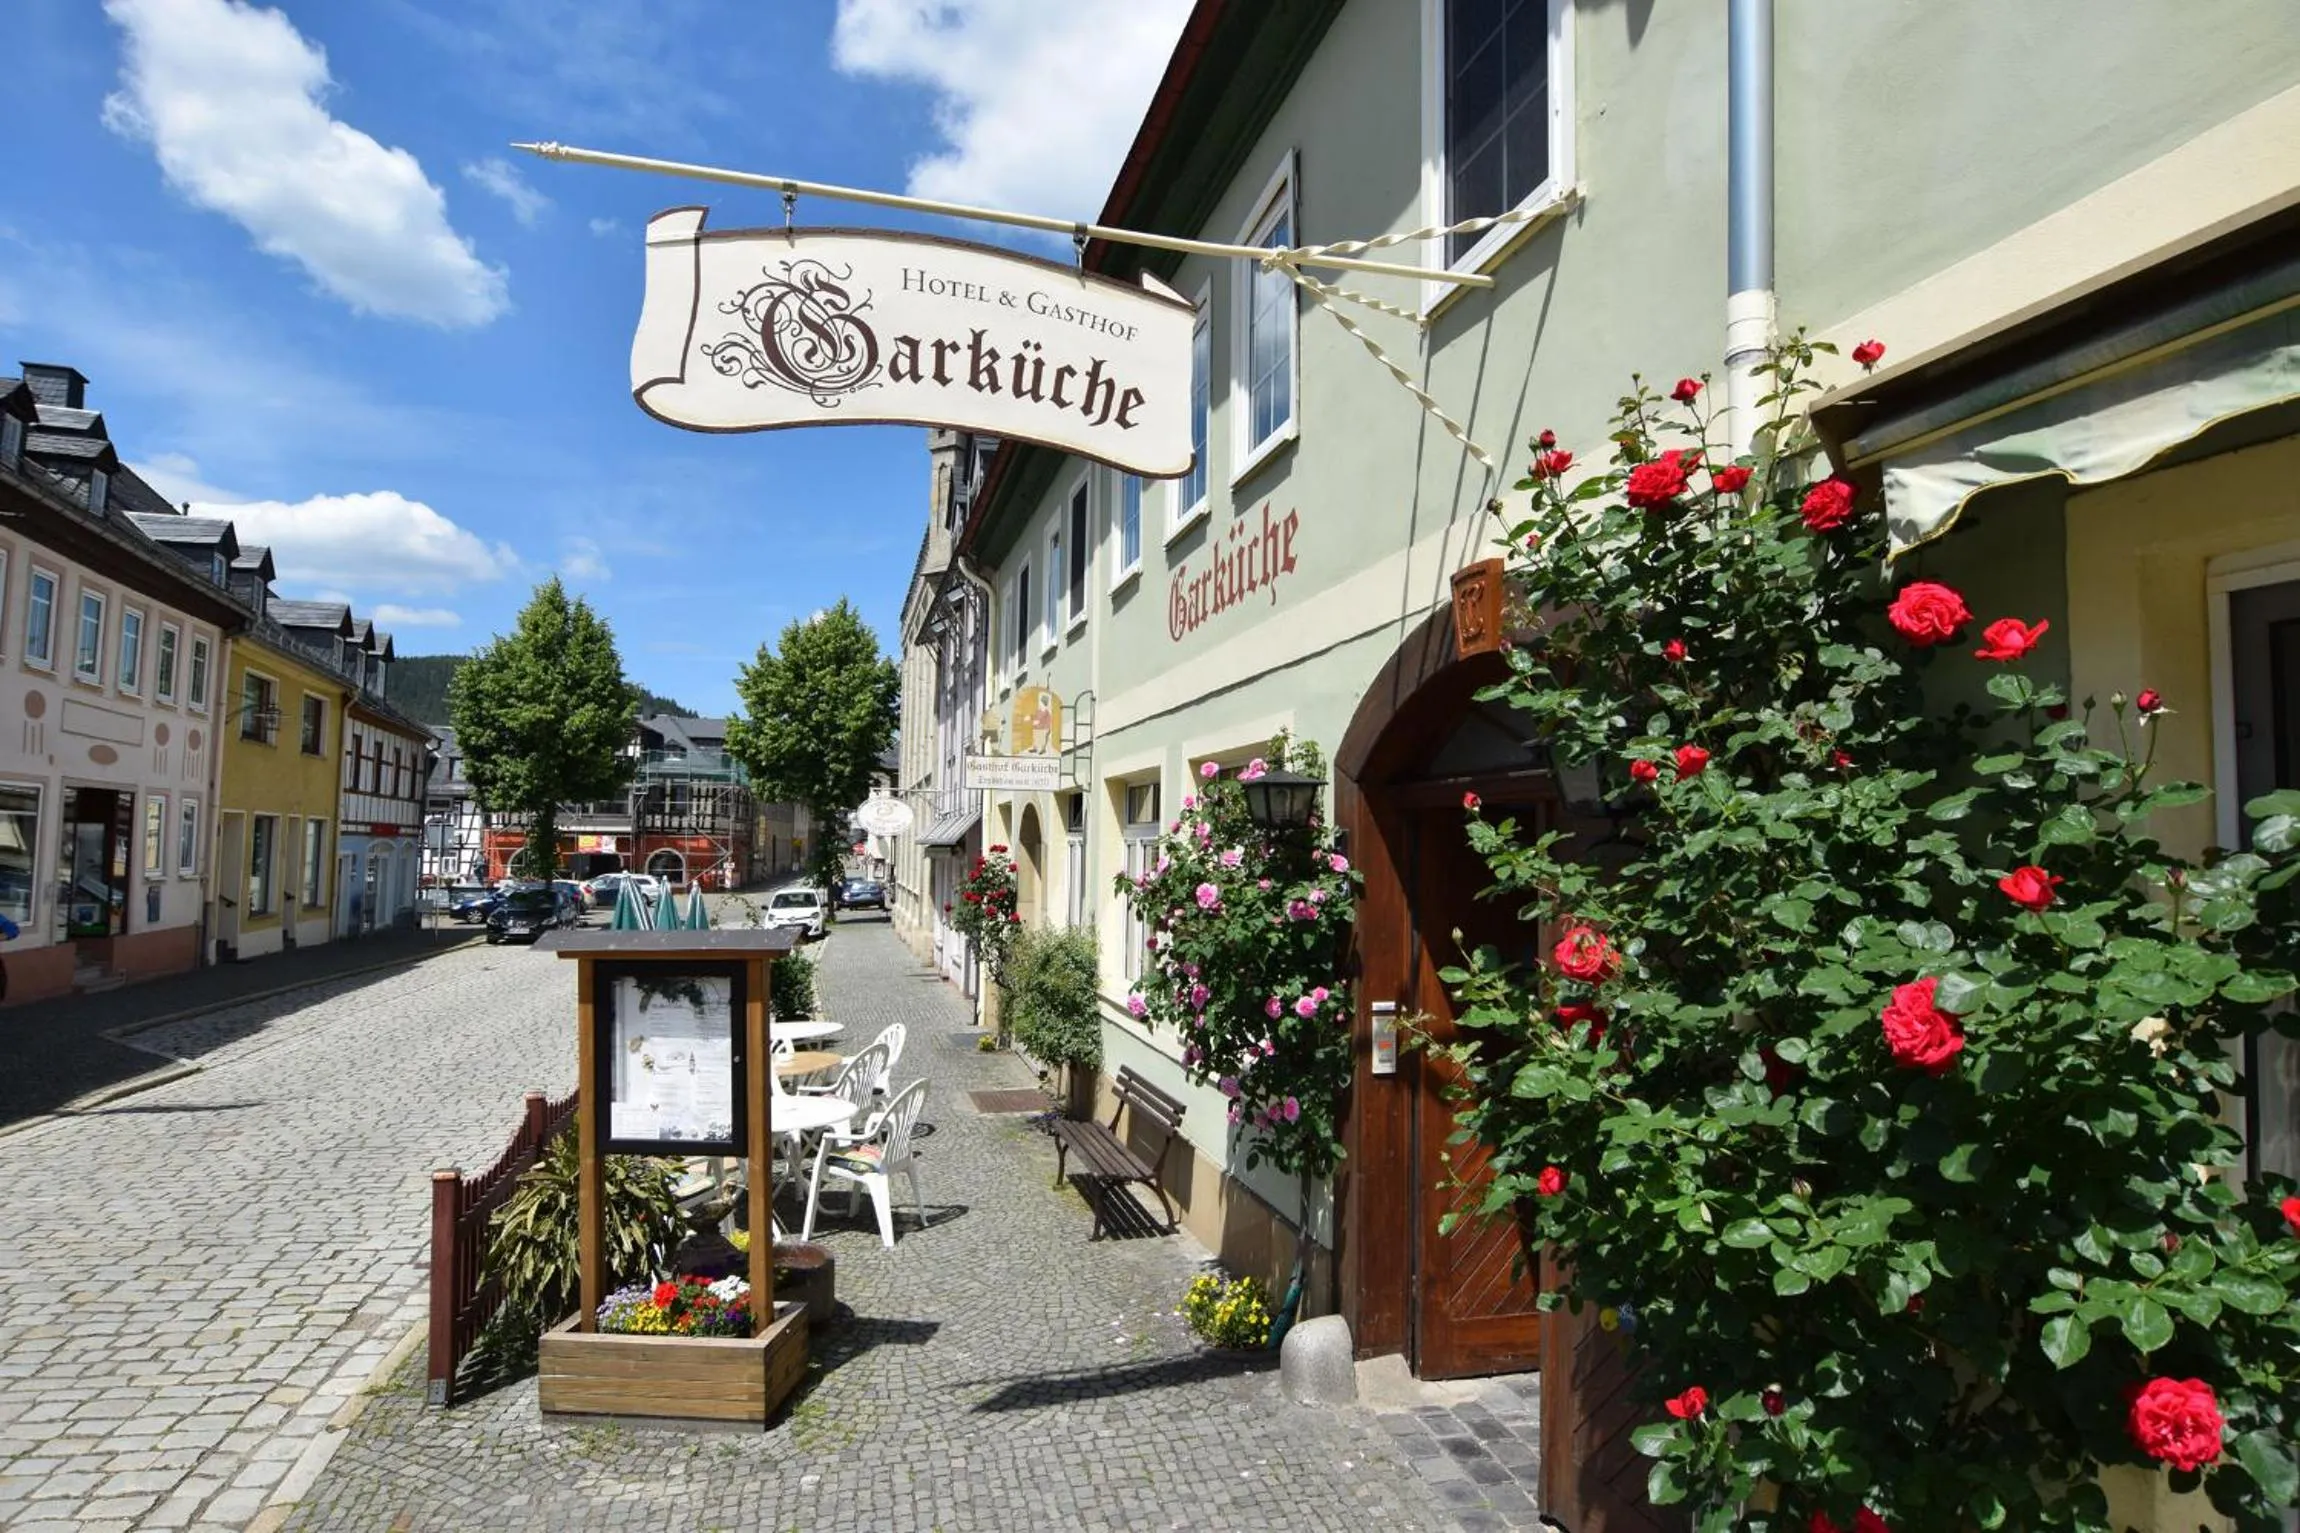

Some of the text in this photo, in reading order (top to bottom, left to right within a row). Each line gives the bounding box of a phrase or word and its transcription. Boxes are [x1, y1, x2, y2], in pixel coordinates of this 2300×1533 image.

[701, 259, 1146, 430] Garküche
[998, 290, 1018, 309] &
[1169, 499, 1299, 642] Garküche
